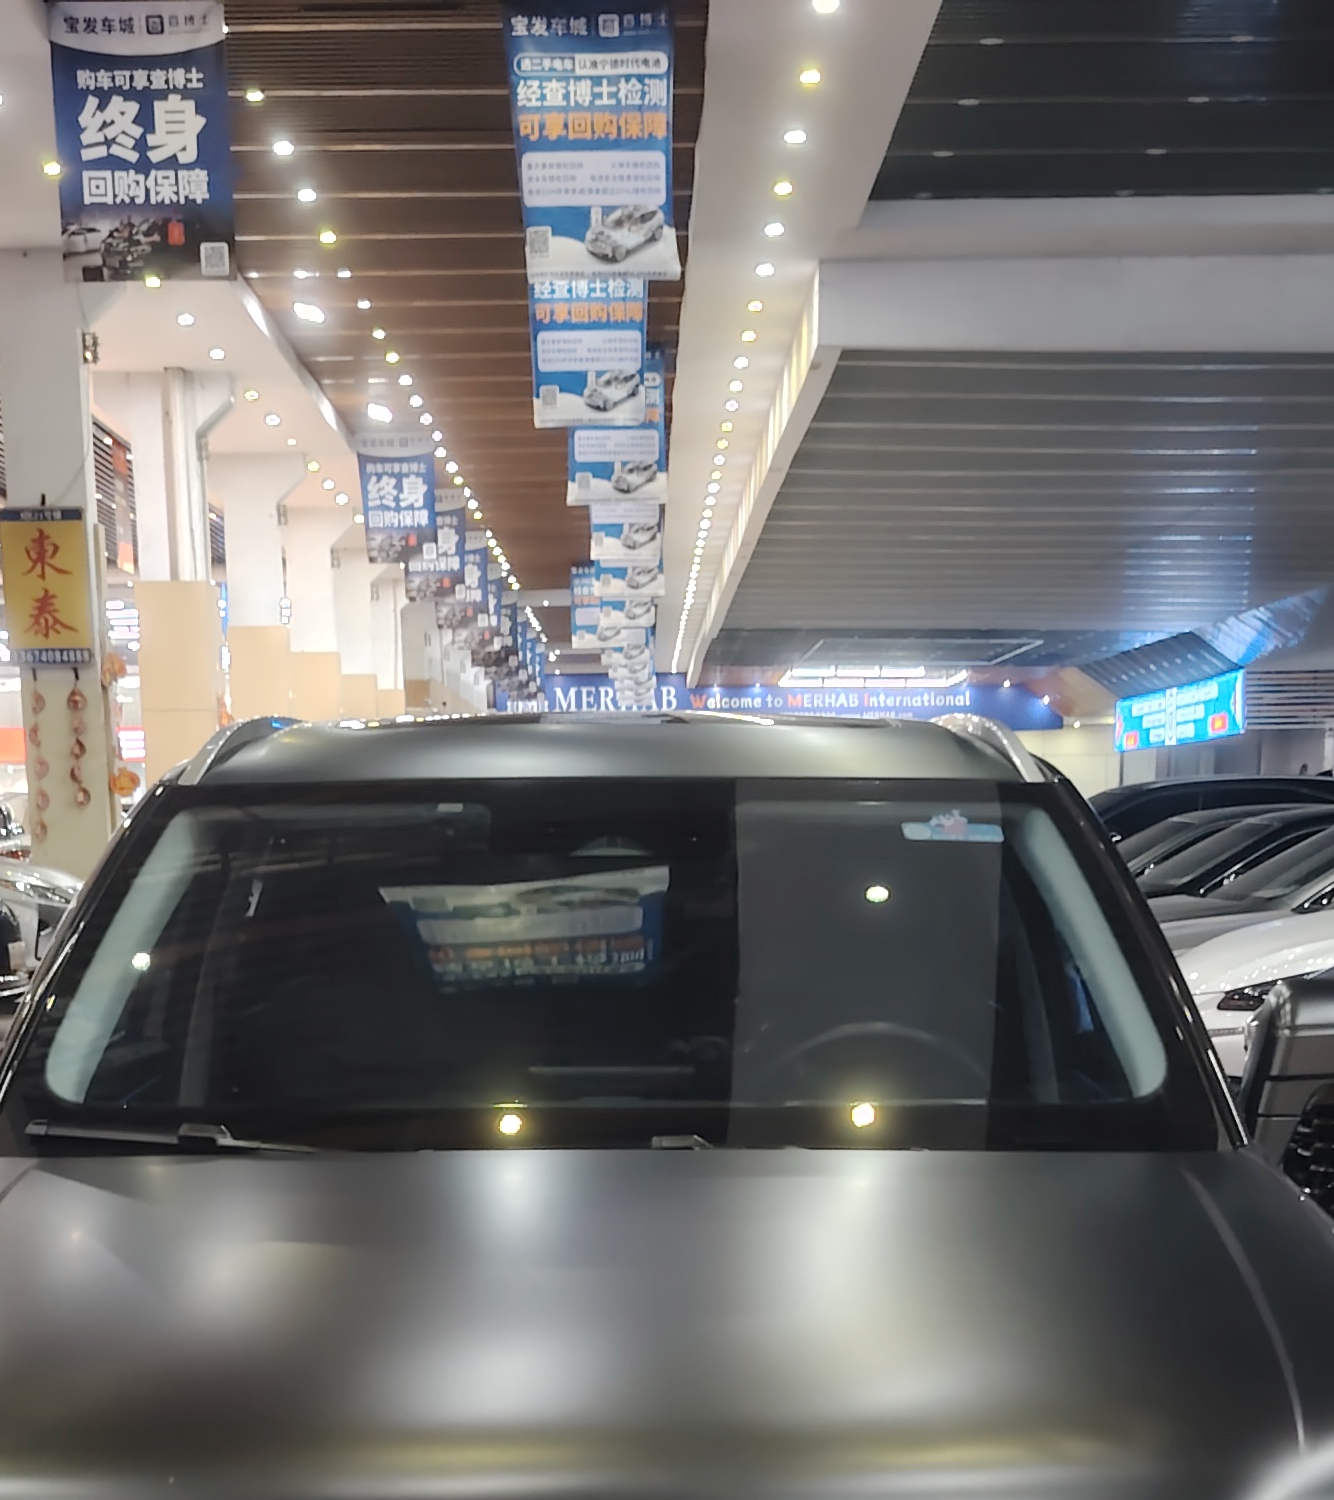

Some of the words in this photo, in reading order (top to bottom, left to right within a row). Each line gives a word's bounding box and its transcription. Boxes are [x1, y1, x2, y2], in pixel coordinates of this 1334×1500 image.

[64, 16, 135, 35] 宝发车城
[511, 15, 589, 36] 宝发车城
[76, 67, 204, 90] 购车可享查博士
[517, 77, 667, 107] 经查博士检测
[78, 94, 207, 164] 终身
[518, 112, 667, 142] 可享回购保障
[82, 169, 210, 205] 回购保障
[367, 474, 428, 508] 终身
[368, 509, 429, 528] 回购保障
[553, 687, 677, 713] MERB
[690, 694, 762, 709] Welcome
[766, 694, 784, 708] to
[787, 693, 859, 708] MERHAB
[864, 690, 971, 708] International
